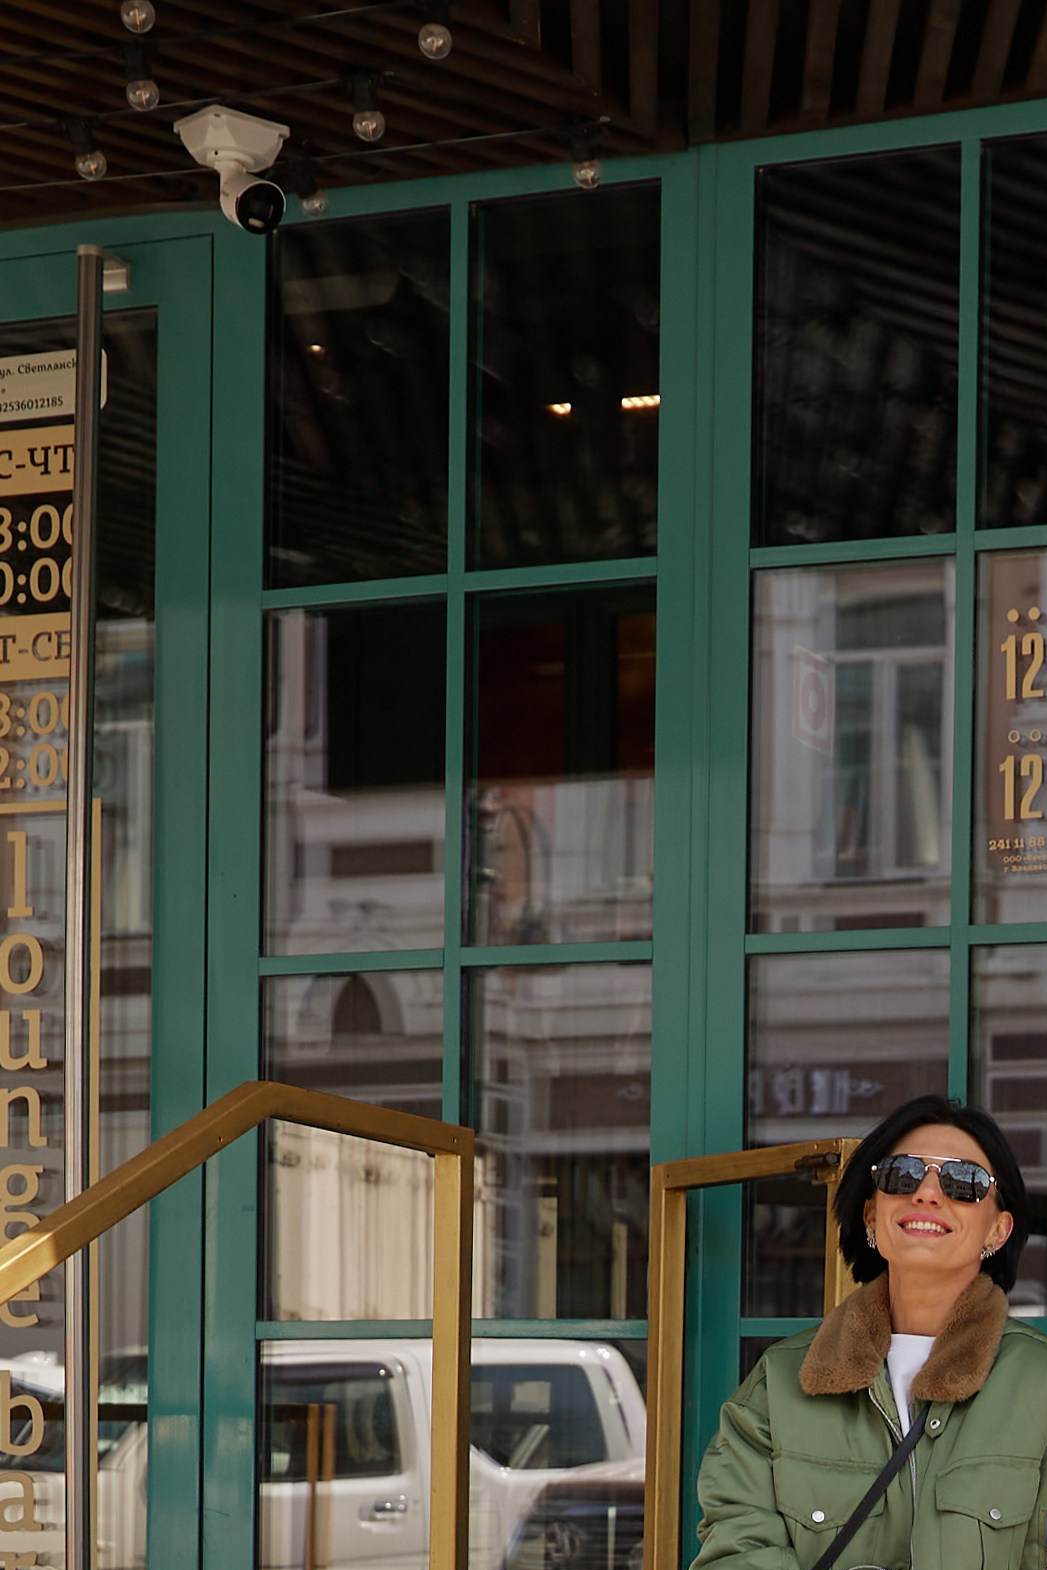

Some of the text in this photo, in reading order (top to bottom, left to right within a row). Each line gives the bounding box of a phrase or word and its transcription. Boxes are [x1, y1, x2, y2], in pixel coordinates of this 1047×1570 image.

[1001, 633, 1044, 699] 12
[999, 754, 1043, 820] 12
[1014, 838, 1024, 849] 11
